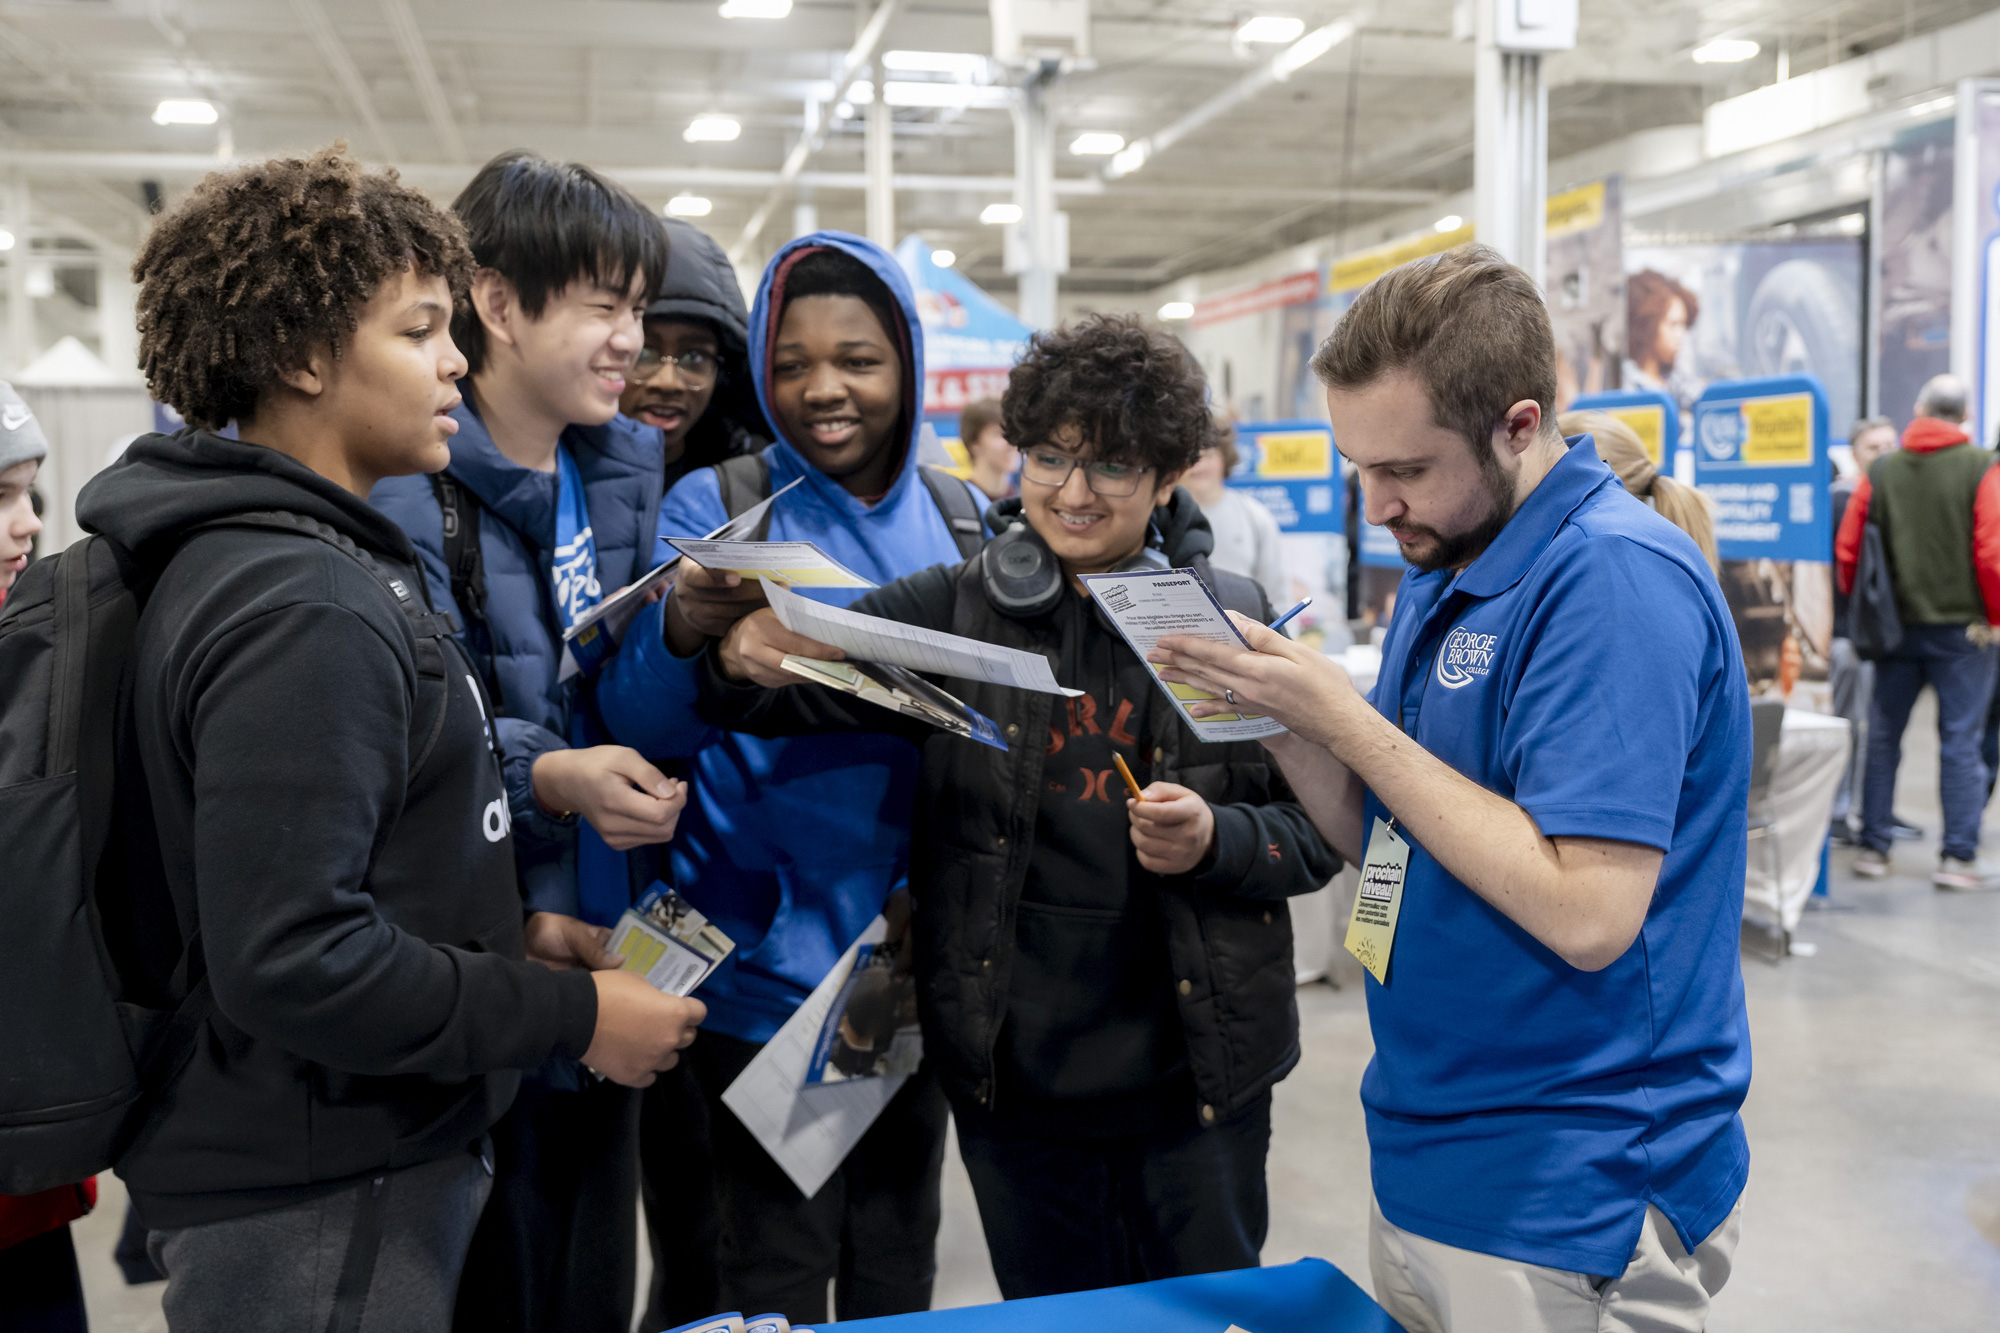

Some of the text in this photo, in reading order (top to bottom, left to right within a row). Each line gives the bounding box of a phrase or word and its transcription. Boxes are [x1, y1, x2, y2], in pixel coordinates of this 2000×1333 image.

[1152, 579, 1192, 588] PASSEPORT
[1449, 631, 1498, 652] GEORGE
[1446, 648, 1495, 668] BROWN
[1465, 666, 1490, 676] COLLEGE
[1365, 863, 1402, 882] prochain
[1361, 880, 1395, 897] niveau!
